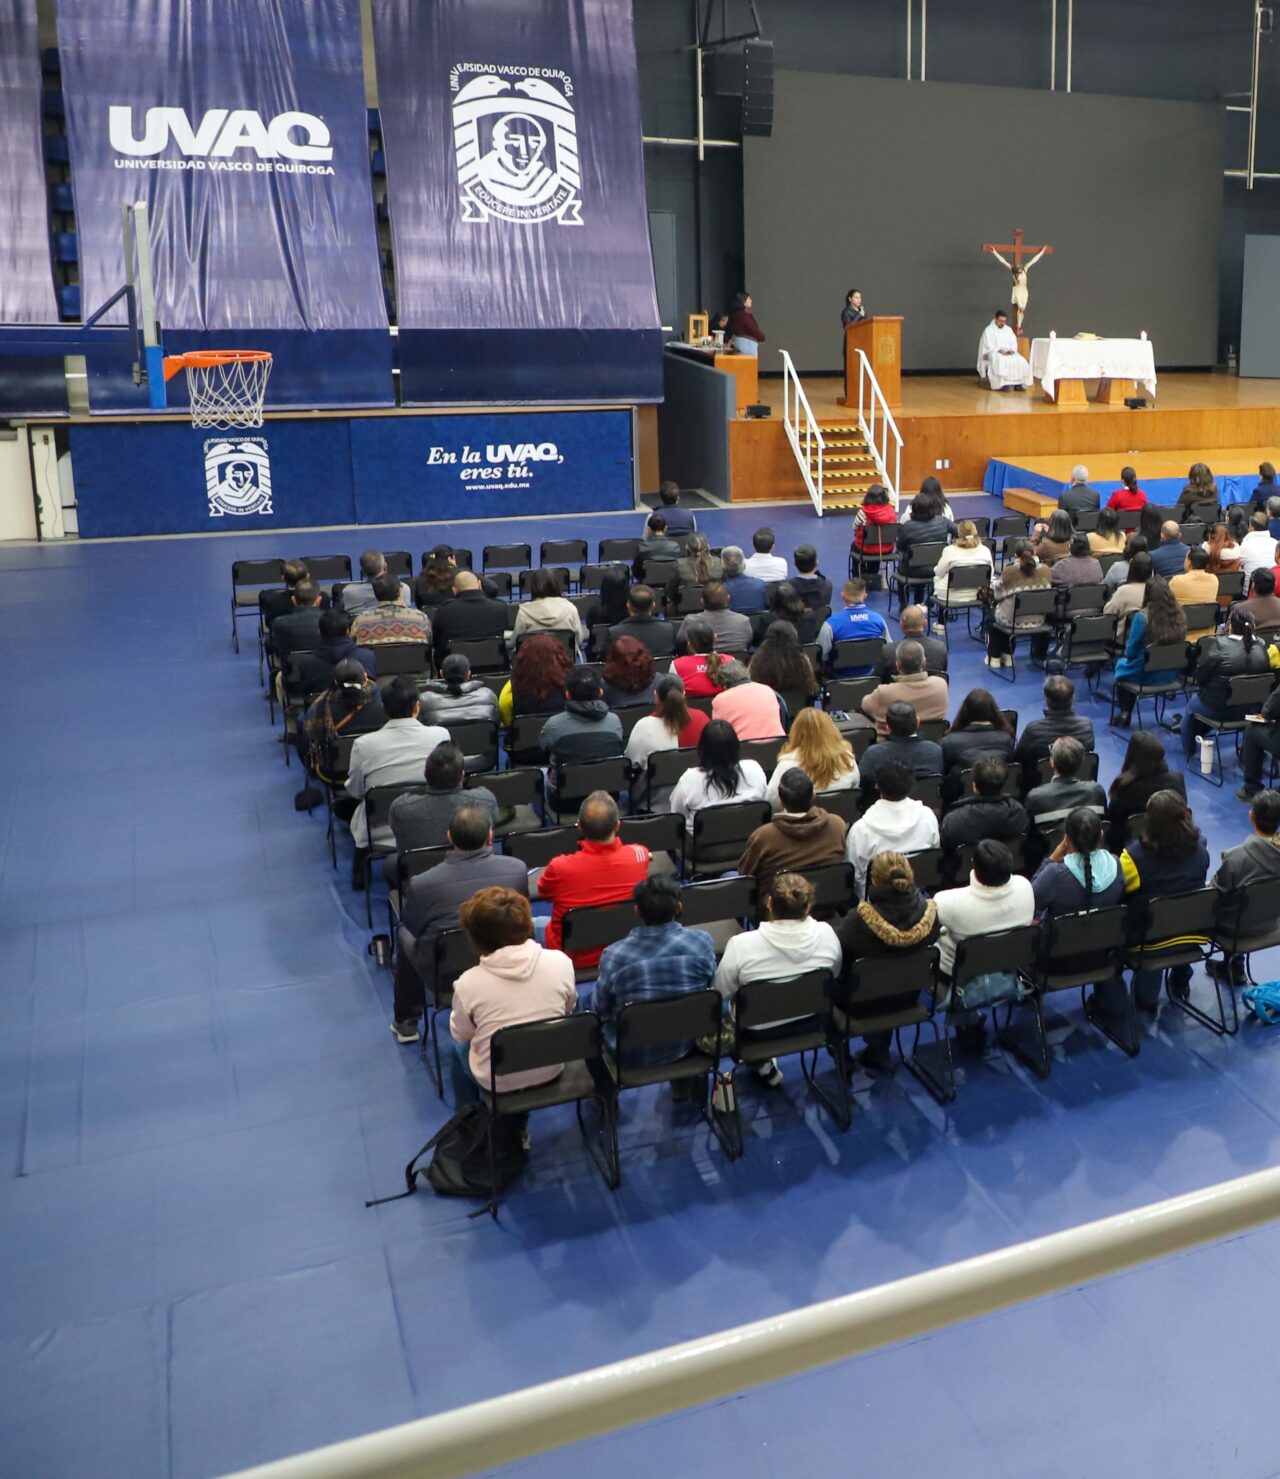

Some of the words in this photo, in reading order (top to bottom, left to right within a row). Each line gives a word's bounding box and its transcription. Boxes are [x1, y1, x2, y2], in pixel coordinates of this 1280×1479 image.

[449, 62, 497, 92] UNIVERSIDAD
[497, 65, 527, 76] VASCO
[528, 67, 541, 77] DE
[541, 68, 574, 97] QUIROGA
[109, 105, 334, 161] UVAQ
[114, 159, 206, 171] UNIVERSIDAD
[207, 161, 253, 172] VASCO
[255, 162, 273, 173] DE
[275, 163, 336, 176] QUIROGA
[474, 185, 516, 217] EDUCERE
[516, 209, 529, 218] IN
[529, 188, 568, 217] VERITATE
[426, 446, 458, 465] En
[461, 446, 481, 464] la
[486, 442, 564, 464] UVAQ,
[460, 467, 503, 480] eres
[507, 461, 534, 478] tú.
[465, 482, 530, 491] www.uvaq.edu.mx
